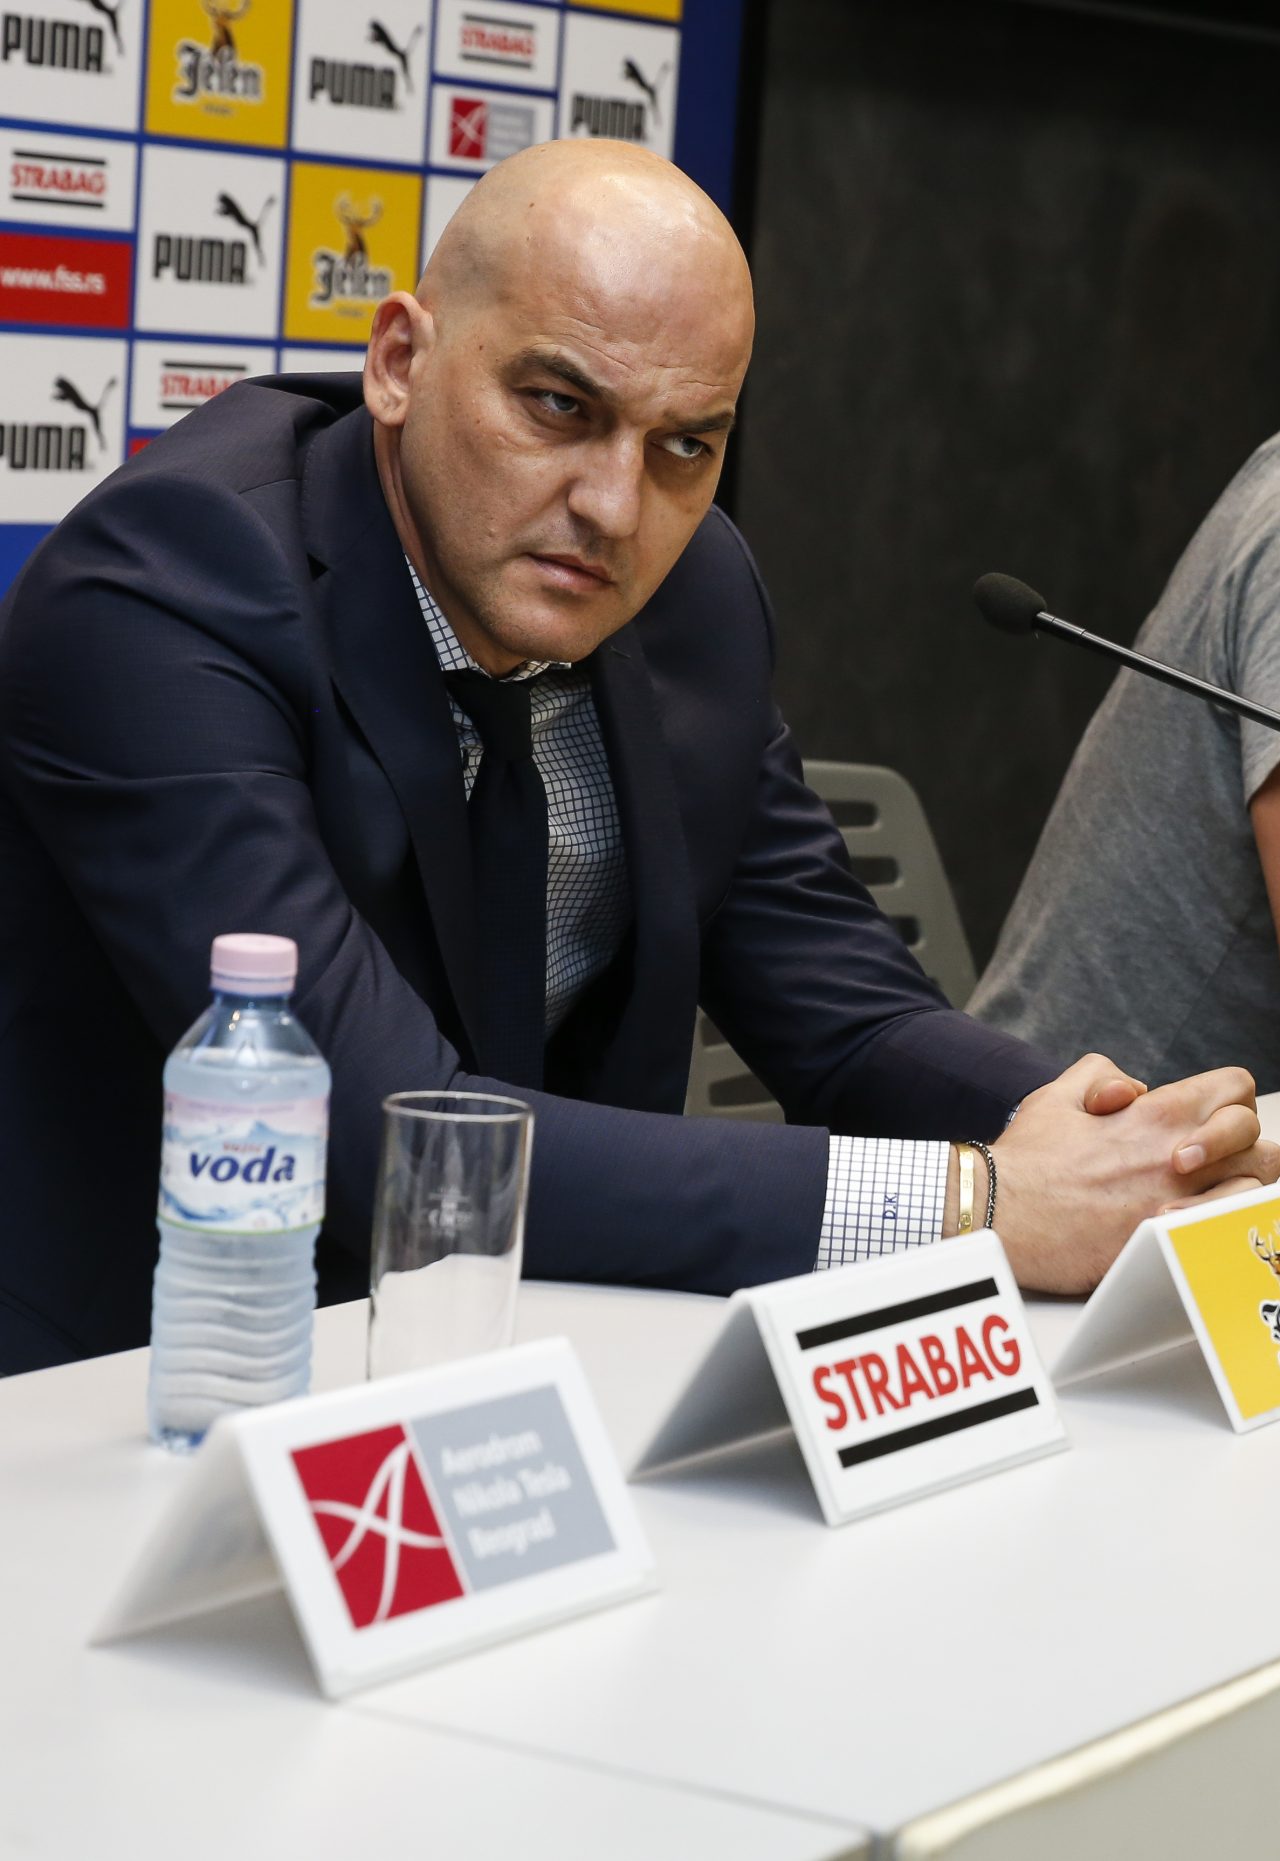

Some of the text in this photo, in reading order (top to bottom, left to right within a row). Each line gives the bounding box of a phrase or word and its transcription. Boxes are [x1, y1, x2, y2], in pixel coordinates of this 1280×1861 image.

[2, 14, 104, 73] PUMA
[177, 40, 262, 99] Jelen
[309, 57, 396, 110] PUMA
[572, 94, 645, 140] PUMA
[11, 163, 105, 197] STRABAG
[0, 264, 105, 295] www.fss.rs
[154, 233, 247, 284] PUMA
[313, 250, 392, 305] Jelen
[0, 424, 86, 470] UMA
[190, 1145, 295, 1184] voda
[811, 1314, 1022, 1431] STRABAG
